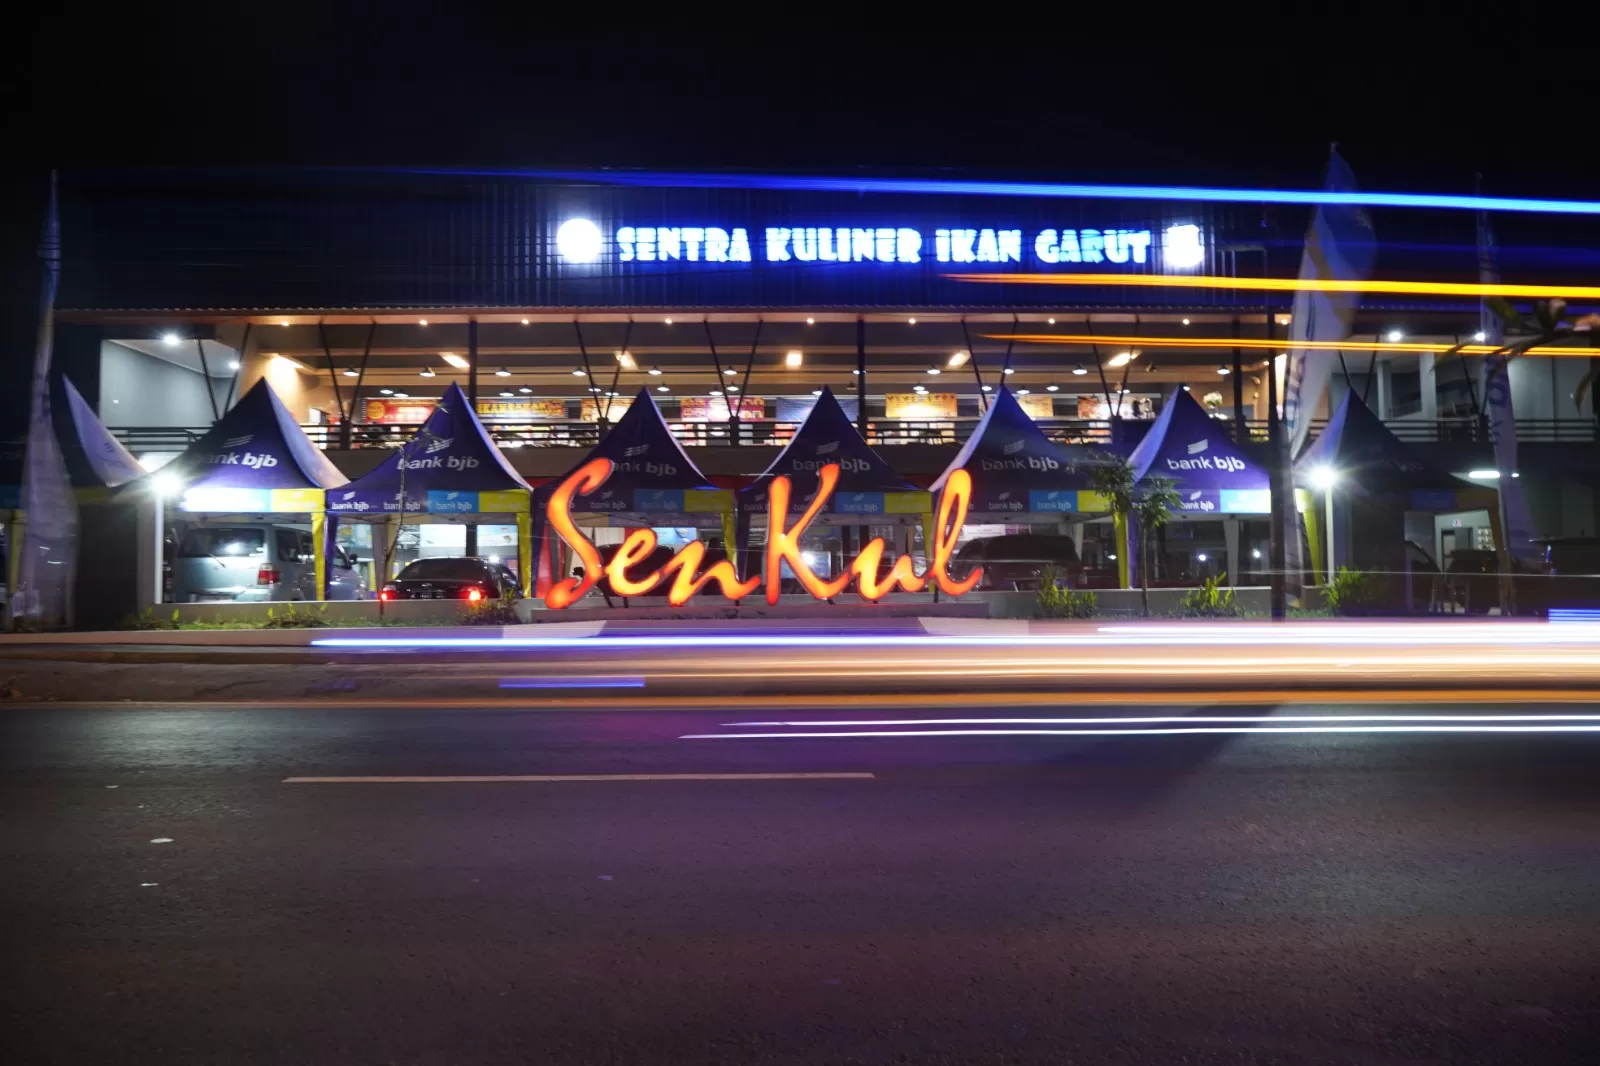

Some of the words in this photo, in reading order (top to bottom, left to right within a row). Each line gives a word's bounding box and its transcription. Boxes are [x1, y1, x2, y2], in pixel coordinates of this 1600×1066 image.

[616, 227, 752, 262] SENTRA
[765, 227, 922, 263] KULINER
[936, 229, 1021, 263] IKAN
[1035, 229, 1151, 263] GARUT
[197, 452, 240, 465] ank
[241, 452, 278, 469] bjb
[397, 456, 444, 469] bank
[447, 456, 480, 471] bjb
[839, 458, 871, 473] bjb
[981, 457, 1026, 471] bank
[1028, 456, 1059, 472] bjb
[1167, 457, 1213, 470] bank
[1214, 456, 1245, 472] bjb
[645, 462, 677, 476] bjb
[331, 502, 353, 510] bank
[353, 502, 370, 512] bjb
[405, 502, 421, 512] bjb
[435, 502, 456, 510] bank
[457, 502, 473, 512] bjb
[1009, 502, 1023, 511] bjb
[1058, 502, 1072, 511] bjb
[1200, 501, 1215, 512] bjb
